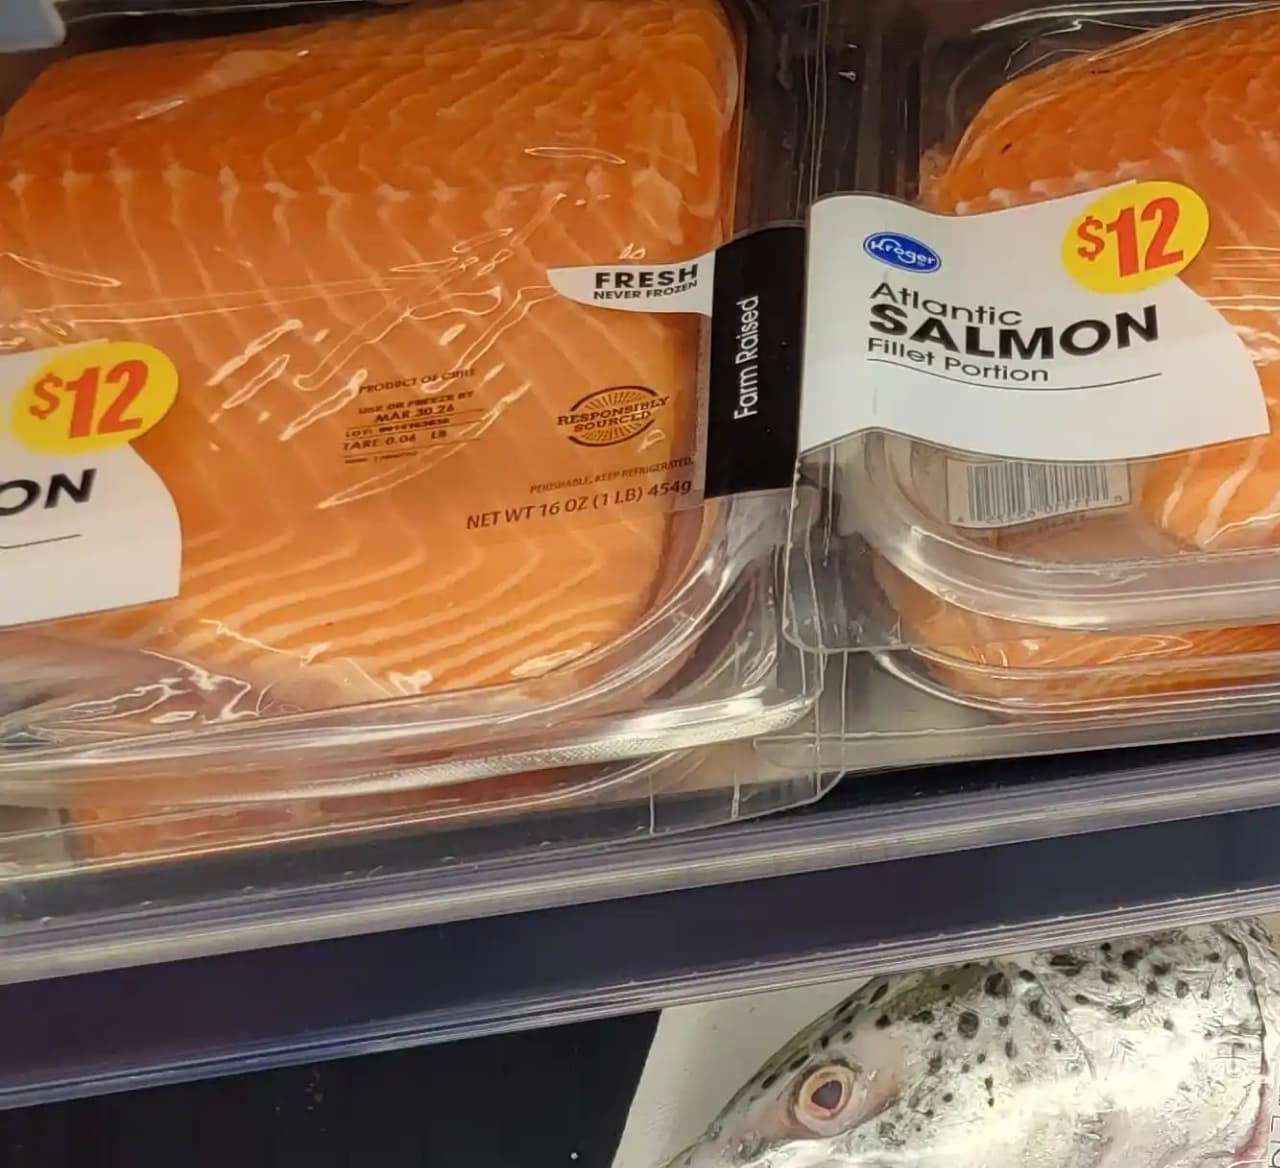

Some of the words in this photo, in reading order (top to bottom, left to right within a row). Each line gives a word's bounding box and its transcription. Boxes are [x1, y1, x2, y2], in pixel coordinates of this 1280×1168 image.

[869, 237, 936, 266] Kroger
[1077, 197, 1183, 278] $12
[593, 290, 641, 300] NEVER
[646, 280, 698, 298] FROZEN
[595, 264, 698, 289] FRESH
[870, 282, 1022, 327] Atlantic
[736, 296, 759, 365] Raised
[869, 304, 1159, 361] SALMON
[868, 337, 935, 367] Fillet
[945, 356, 1049, 382] Portion
[29, 359, 149, 439] $12
[557, 396, 670, 426] RESPONSIBLY
[734, 368, 758, 420] Farm
[574, 411, 651, 433] SOURCED
[466, 511, 500, 530] NET
[504, 505, 535, 524] WT
[539, 501, 560, 518] 16
[565, 496, 590, 514] OZ
[592, 492, 609, 509] (1
[614, 486, 643, 504] LB)
[647, 478, 693, 498] 454g
